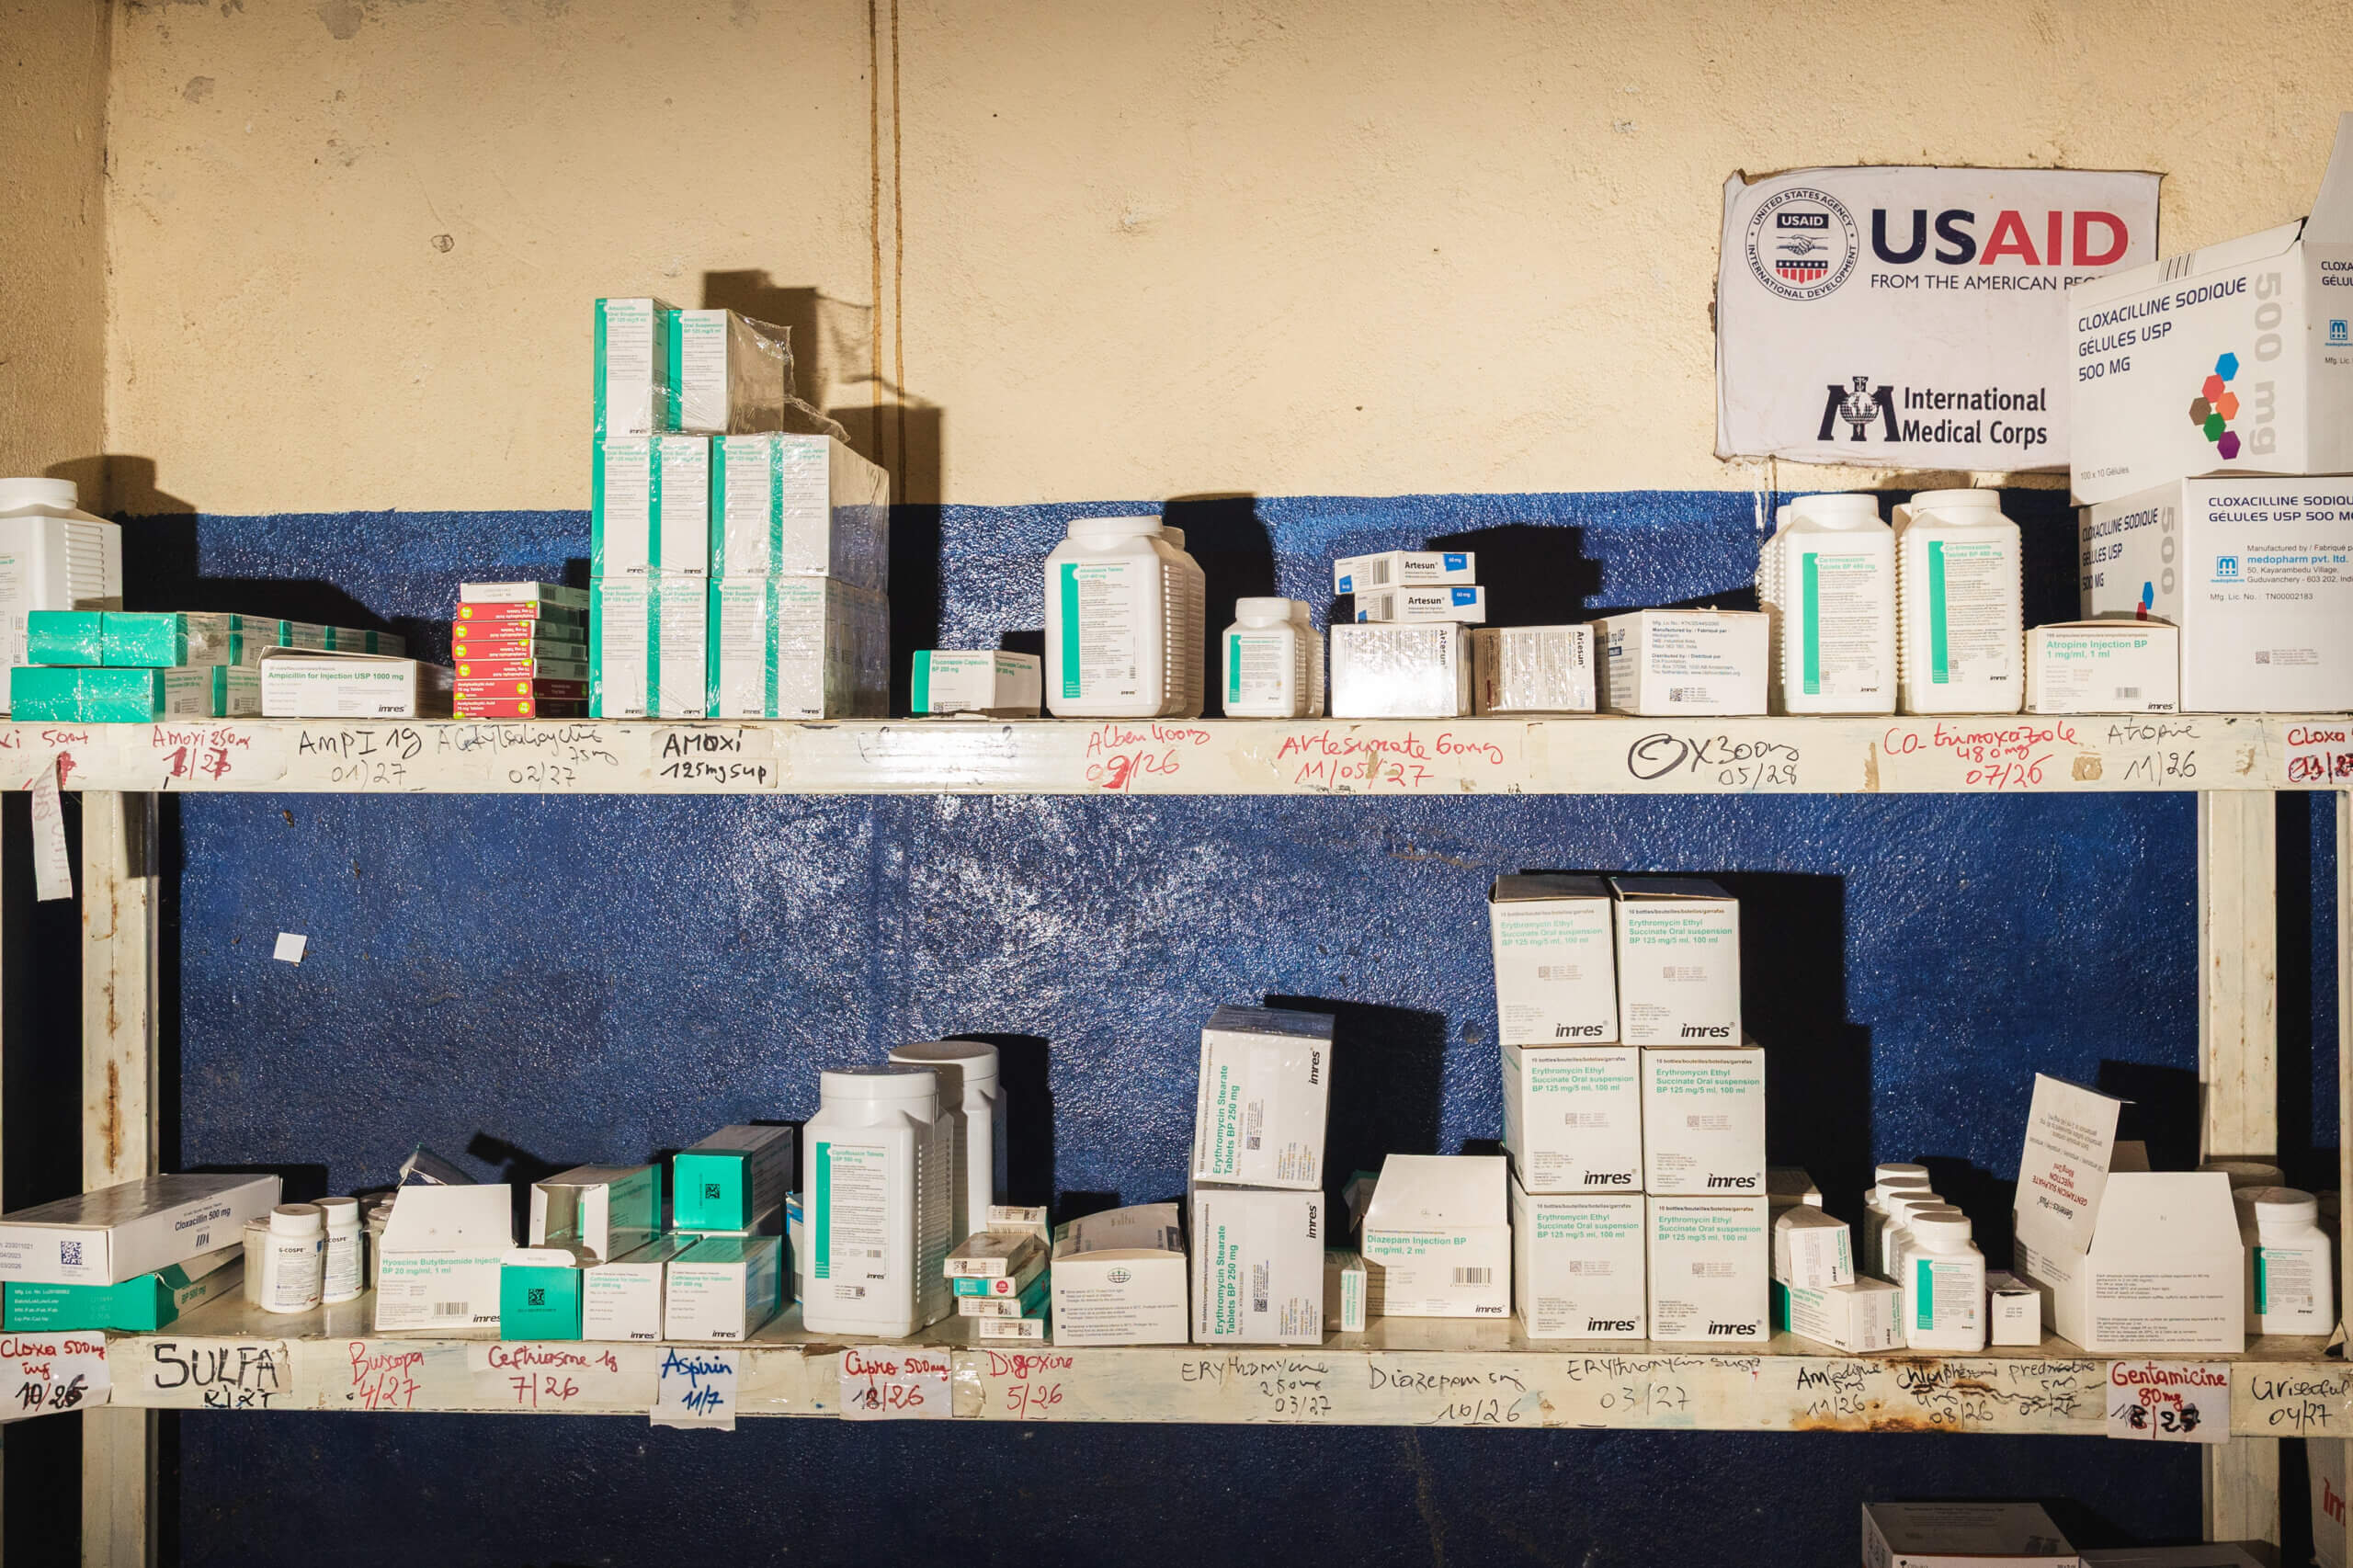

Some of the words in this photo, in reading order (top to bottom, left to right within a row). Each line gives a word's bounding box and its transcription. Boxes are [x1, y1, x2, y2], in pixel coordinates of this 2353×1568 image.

[1753, 195, 1783, 226] UNITED
[1784, 190, 1820, 200] STATES
[1821, 195, 1853, 227] AGENCY
[1781, 215, 1824, 226] USAID
[1871, 208, 2130, 267] USAID
[1747, 244, 1805, 299] INTERNATIONAL
[1807, 245, 1857, 299] DEVELOPMENT
[1870, 274, 1919, 289] FROM
[1924, 274, 1960, 290] THE
[1963, 275, 2057, 290] AMERICAN
[2078, 295, 2171, 333] CLOXACILLINE
[2175, 276, 2248, 310] SODIQUE
[2255, 271, 2282, 362] 500
[2078, 328, 2136, 358] GÉLULES
[2141, 321, 2173, 342] USP
[2078, 362, 2105, 382] 500
[2109, 356, 2131, 374] MG
[1904, 386, 2047, 412] International
[2248, 381, 2277, 456] mg
[1902, 419, 1982, 444] Medical
[1989, 420, 2048, 450] Corps
[2208, 495, 2299, 506] CLOXACILLINE
[2124, 507, 2159, 531] SODIQUE
[2209, 510, 2268, 522] GÉLULES
[2273, 511, 2302, 521] USP
[2305, 511, 2335, 521] 500
[2108, 542, 2123, 560] USP
[2246, 544, 2297, 552] Manufactured
[1404, 561, 1436, 570] Artesun
[2246, 554, 2308, 565] medopharm
[2311, 555, 2330, 565] pvt.
[2333, 554, 2349, 563] ltd.
[1408, 597, 1442, 605] Artesun
[2046, 640, 2087, 651] Atropine
[2090, 640, 2131, 650] Injection
[2133, 640, 2148, 648] BP
[2098, 650, 2110, 658] ml
[268, 672, 307, 680] Ampicillin
[320, 672, 353, 681] Injection
[373, 672, 391, 680] 1000
[378, 704, 405, 712] imres
[2147, 701, 2174, 710] imres
[1629, 919, 1681, 929] Erythromycin
[1683, 918, 1703, 927] Ethyl
[1629, 927, 1668, 936] Succinate
[1669, 926, 1686, 936] Oral
[1688, 926, 1733, 937] suspension
[1693, 936, 1707, 944] 100
[1708, 936, 1718, 944] ml
[1555, 1023, 1603, 1038] imres
[1680, 1022, 1730, 1038] imres
[1308, 1051, 1321, 1085] imres
[1656, 1069, 1709, 1078] Erythromycin
[1710, 1068, 1731, 1078] Ethyl
[1217, 1064, 1229, 1106] Stearate
[1656, 1077, 1695, 1085] Succinate
[1697, 1077, 1712, 1085] Oral
[1714, 1077, 1760, 1087] suspension
[1230, 1085, 1241, 1101] mg
[1228, 1103, 1237, 1121] 250
[1226, 1123, 1236, 1137] BP
[1212, 1108, 1225, 1175] Erythromycin
[1223, 1140, 1234, 1175] Tablets
[1584, 1170, 1632, 1185] imres
[1707, 1172, 1756, 1188] imres
[175, 1212, 208, 1233] Cloxacillin
[208, 1210, 221, 1222] 500
[221, 1206, 232, 1220] mg
[1306, 1205, 1317, 1239] imres
[1216, 1225, 1226, 1266] Stearate
[1367, 1234, 1410, 1244] Diazepam
[1413, 1235, 1451, 1246] Injection
[1453, 1237, 1467, 1245] BP
[1229, 1244, 1239, 1261] mg
[1227, 1262, 1236, 1279] 250
[1227, 1282, 1236, 1296] BP
[1214, 1267, 1226, 1335] Erythromycin
[1475, 1304, 1503, 1313] imres
[1226, 1300, 1235, 1335] Tablets
[1587, 1317, 1636, 1332] imres
[630, 1331, 654, 1339] imres
[711, 1330, 736, 1338] imres
[1708, 1320, 1756, 1335] imres
[154, 1343, 279, 1391] SULFA
[2111, 1360, 2228, 1388] Gentamicine
